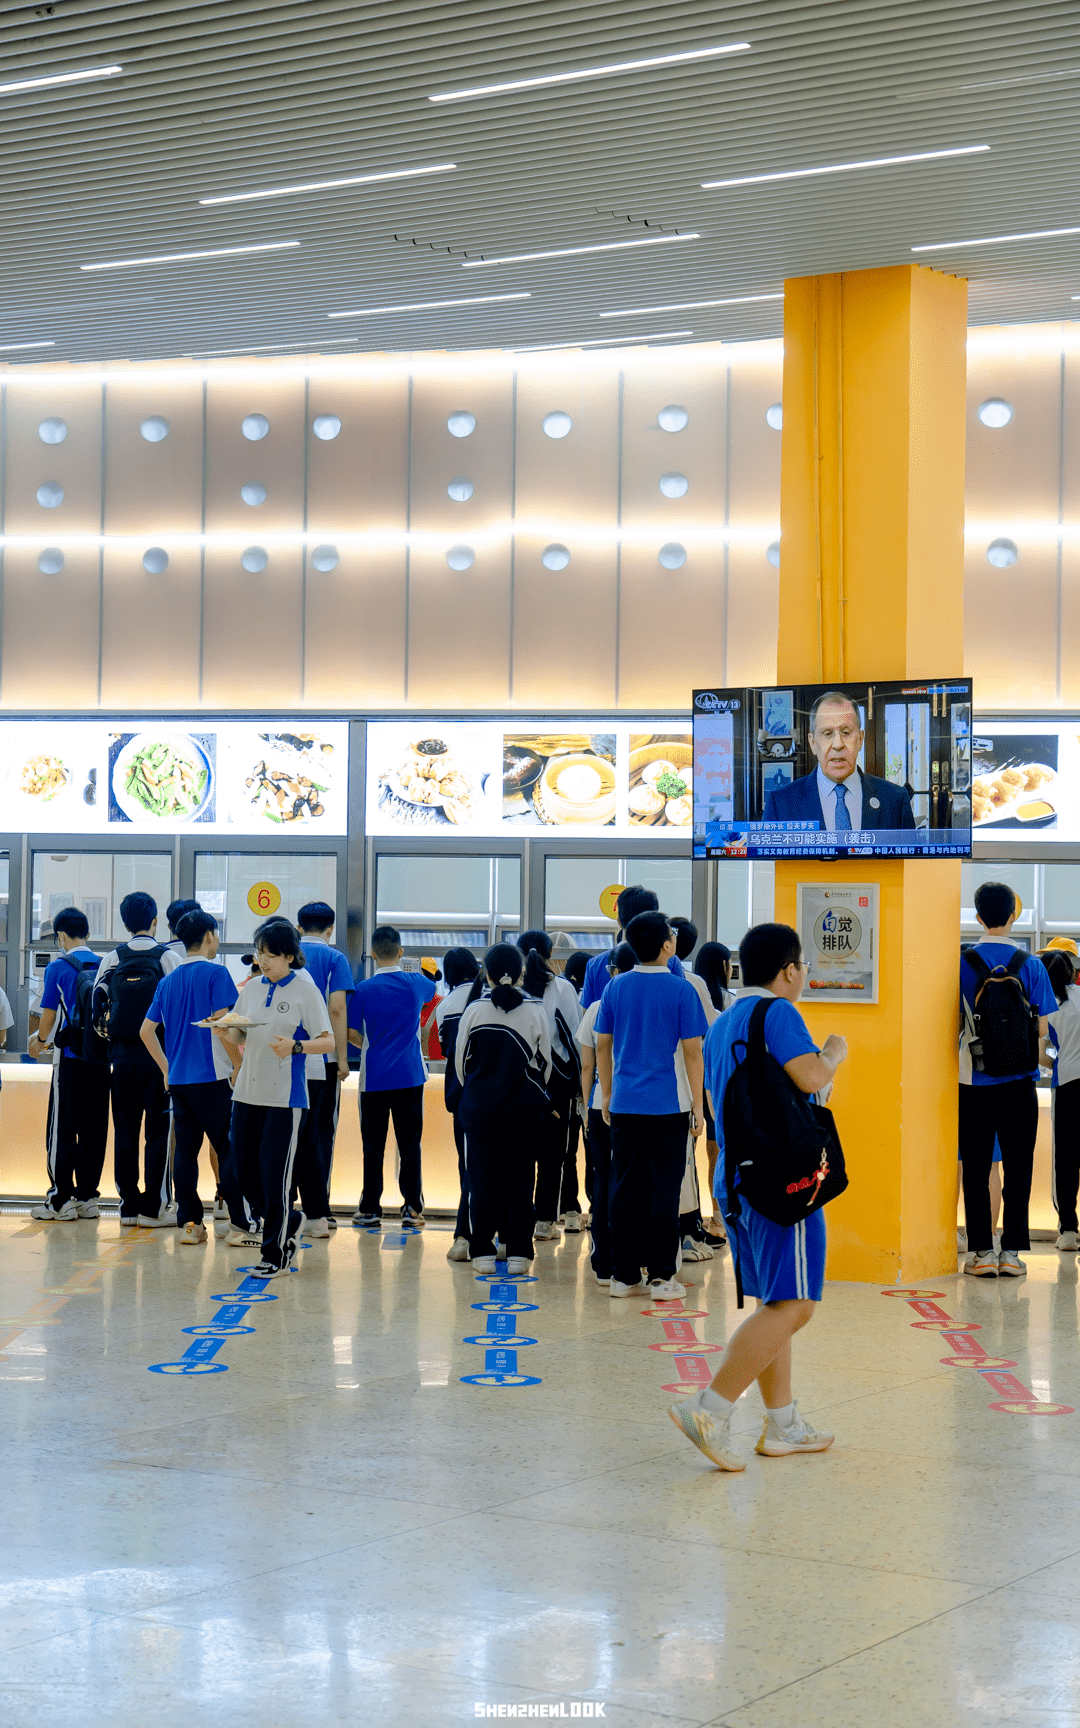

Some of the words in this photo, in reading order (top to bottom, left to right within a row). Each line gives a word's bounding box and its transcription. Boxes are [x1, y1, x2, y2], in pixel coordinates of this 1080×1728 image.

[731, 701, 738, 709] 13
[750, 822, 784, 830] 俄罗斯外长
[786, 822, 815, 830] 拉夫罗夫
[258, 889, 270, 908] 6
[822, 910, 853, 933] 自觉
[822, 934, 853, 951] 排队
